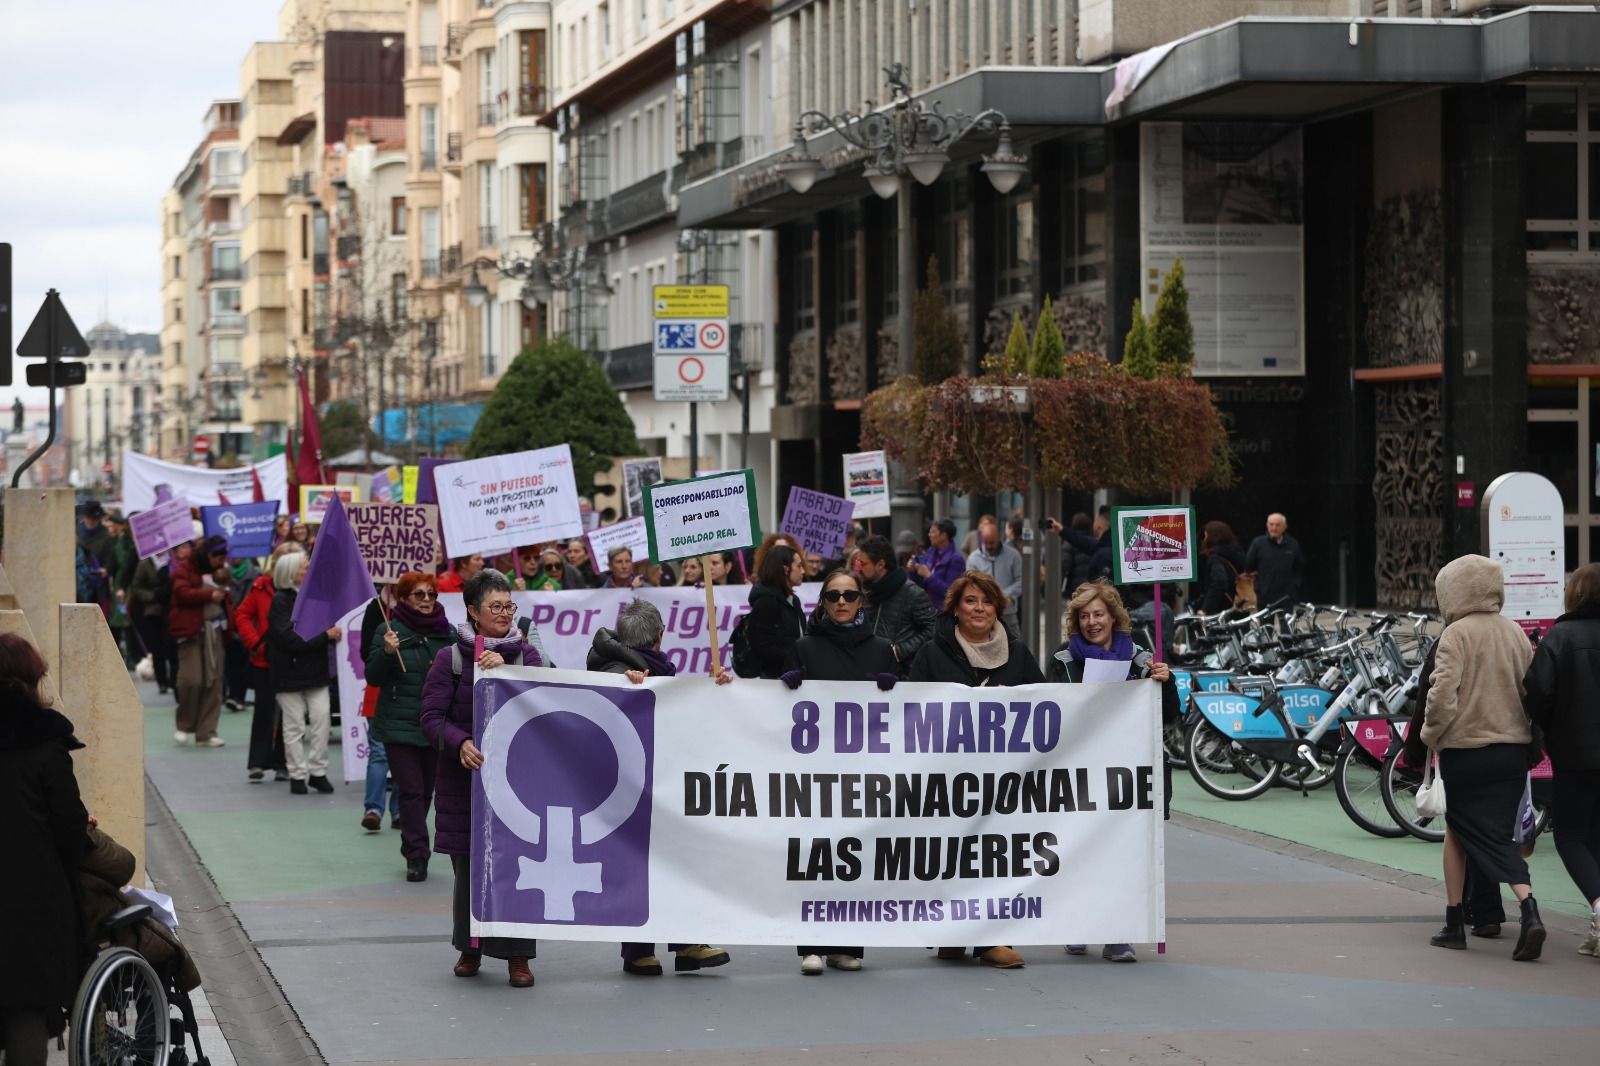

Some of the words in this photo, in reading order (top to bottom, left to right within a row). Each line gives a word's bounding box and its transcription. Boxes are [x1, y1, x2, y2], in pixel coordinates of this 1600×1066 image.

[706, 331, 719, 342] 10
[480, 482, 497, 496] SIN
[501, 474, 544, 492] PUTEROS
[469, 498, 482, 508] NO
[484, 494, 501, 506] HAY
[655, 485, 744, 509] CORRESPONSABILIDAD
[347, 505, 426, 528] MUJERES
[486, 506, 499, 517] NO
[501, 503, 517, 514] HAY
[520, 498, 545, 511] TRATA
[682, 512, 702, 525] para
[704, 509, 719, 519] una
[787, 509, 810, 527] LAS
[671, 531, 714, 547] IGUALDAD
[717, 527, 737, 539] REAL
[804, 538, 824, 553] PAZ
[359, 543, 434, 564] ESISTIMOS
[531, 603, 602, 636] Por
[1207, 699, 1248, 715] alsa
[1283, 693, 1320, 708] alsa
[790, 700, 821, 754] 8
[834, 701, 891, 754] DE
[903, 700, 1062, 754] MARZO
[683, 763, 759, 817] DÍA
[768, 766, 1097, 819] INTERNACIONAL
[1106, 765, 1154, 811] DE
[785, 836, 863, 882] LAS
[873, 831, 1060, 882] MUJERES
[800, 898, 945, 923] FEMINISTAS
[951, 897, 982, 921] DE
[987, 892, 1043, 920] LEÓN
